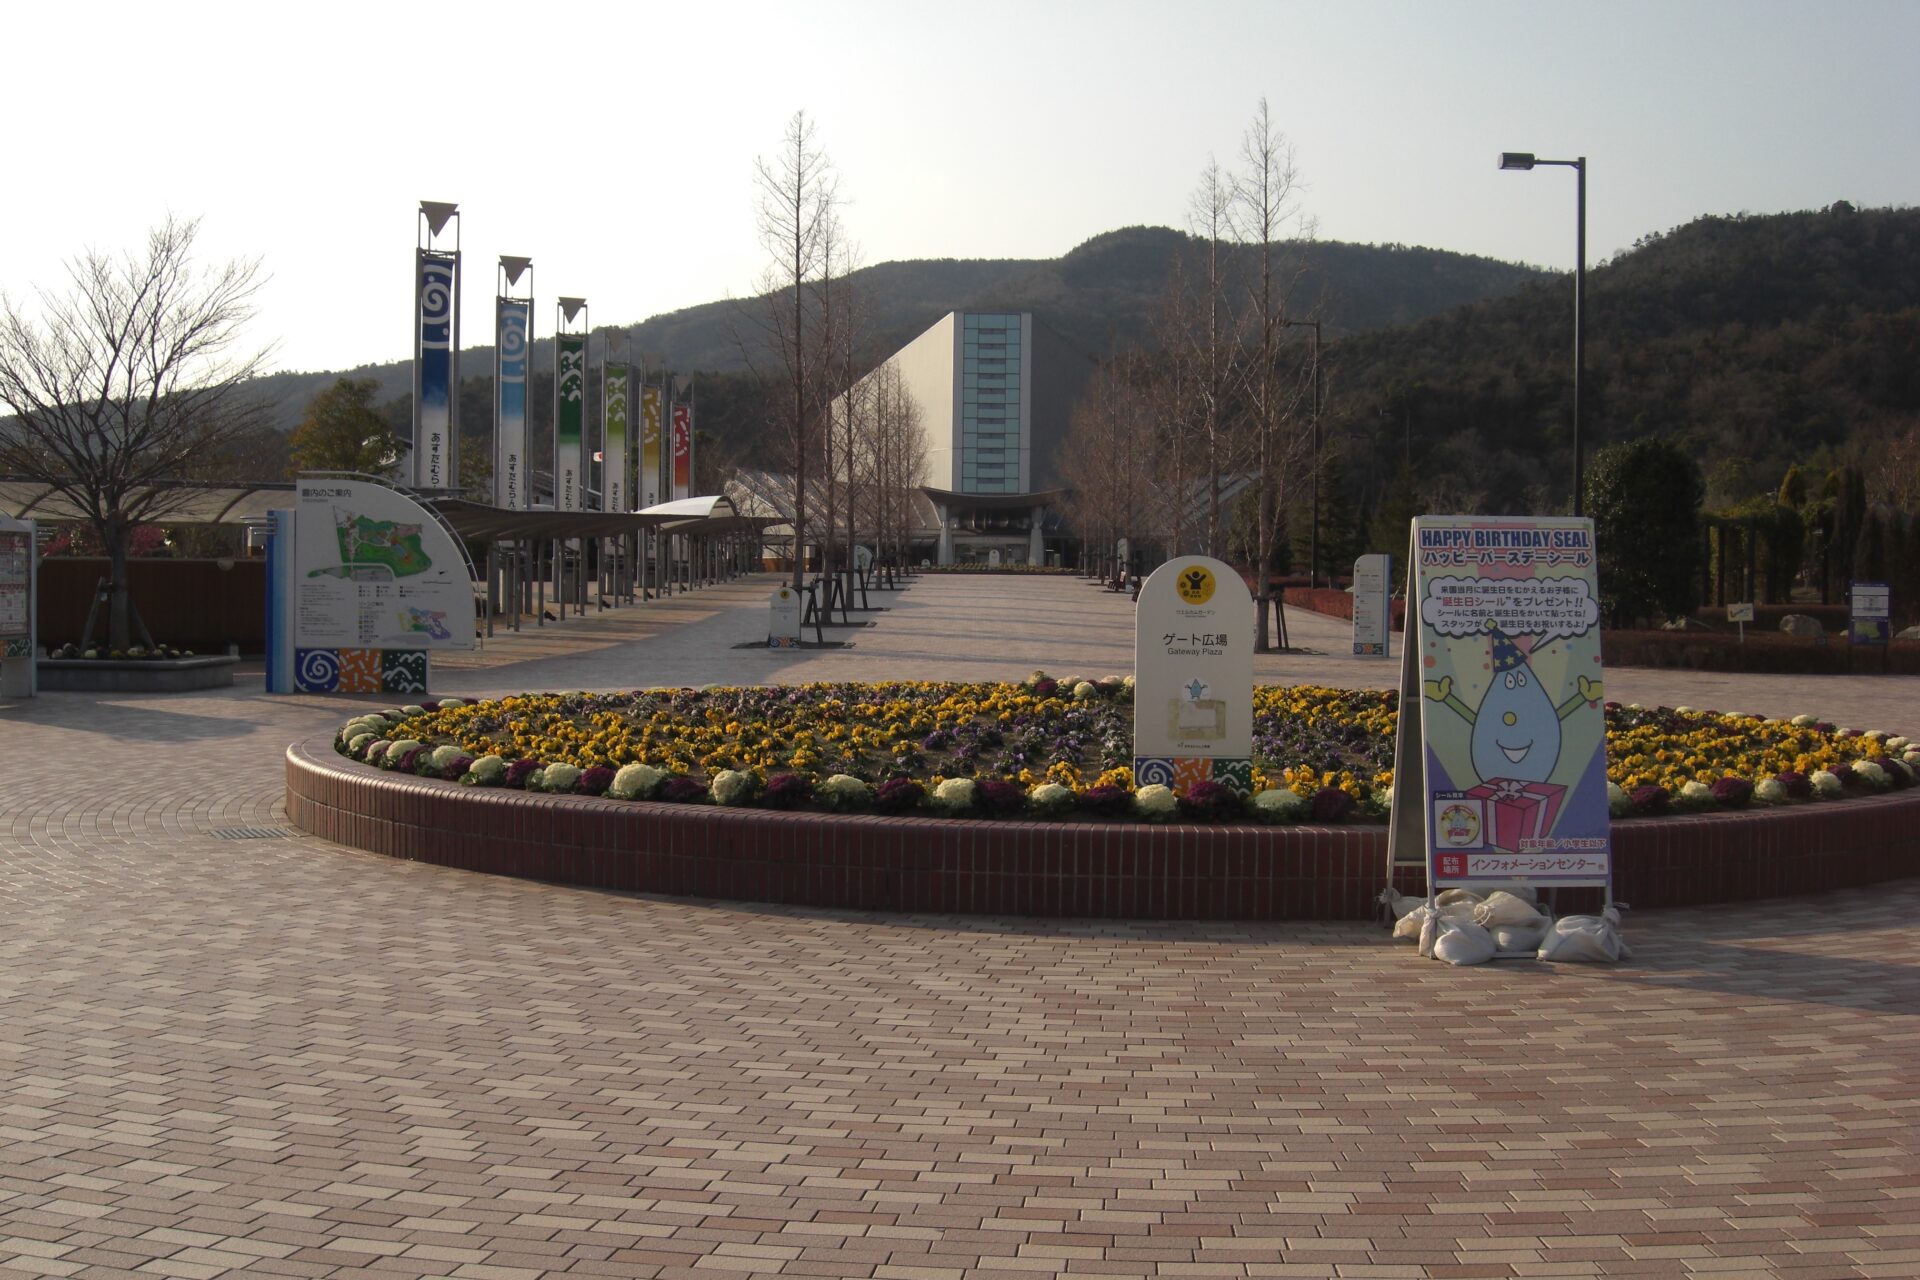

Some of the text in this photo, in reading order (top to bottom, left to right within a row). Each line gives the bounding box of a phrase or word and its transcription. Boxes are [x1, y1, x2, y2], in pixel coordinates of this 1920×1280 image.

[430, 432, 441, 487] あすたむら
[508, 454, 517, 510] あすたむらん
[1421, 530, 1589, 548] HAPPY BIRTHDAY SEAL
[1423, 551, 1589, 566] ハッピーバースデーシール
[1162, 633, 1228, 647] ゲート広場
[1167, 648, 1223, 657] Gateway Plaza
[1442, 856, 1460, 865] 配布
[1471, 858, 1597, 870] インフォメーションセンター
[1442, 865, 1460, 874] 場所
